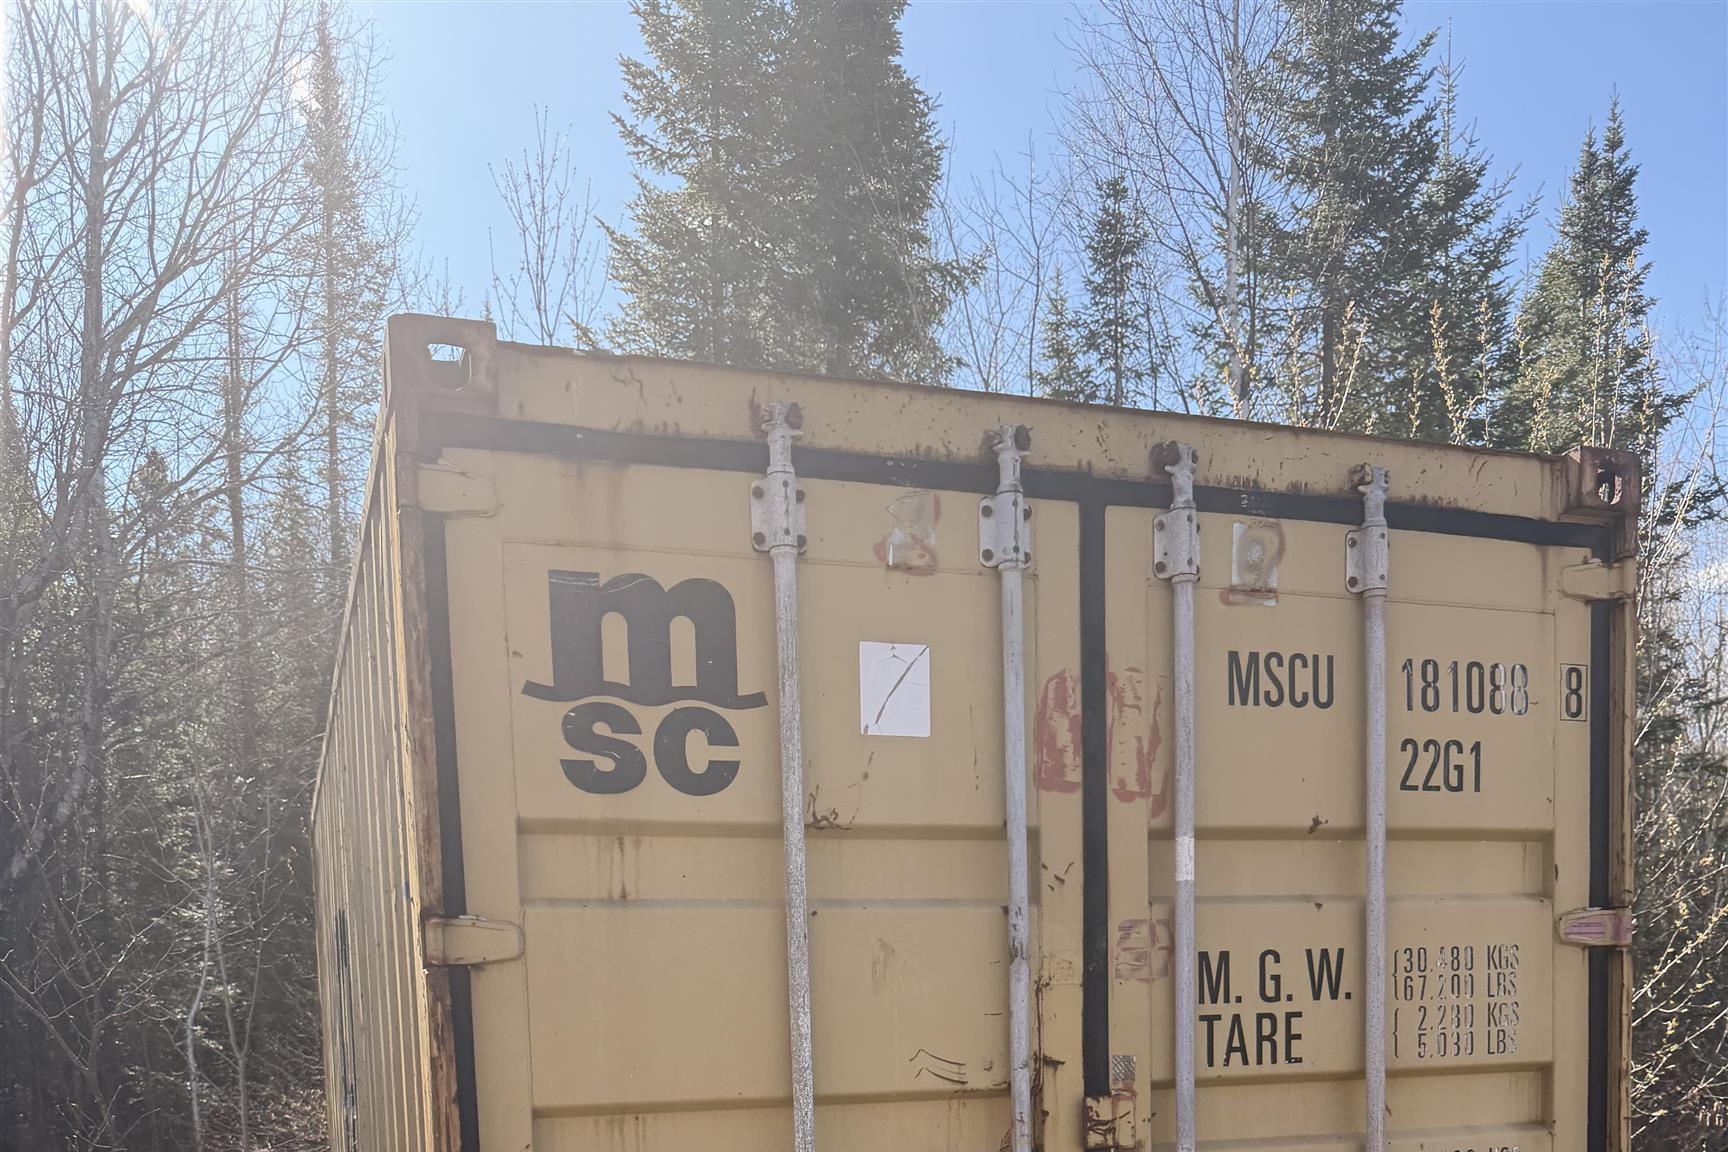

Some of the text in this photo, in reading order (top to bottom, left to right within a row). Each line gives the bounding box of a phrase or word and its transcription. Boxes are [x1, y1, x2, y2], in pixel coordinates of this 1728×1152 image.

[1227, 650, 1583, 719] MSCU 181088 8
[1400, 738, 1482, 793] 22G1
[1487, 944, 1519, 970] KGS
[1487, 971, 1517, 998] LBS
[1199, 1011, 1303, 1067] TARE
